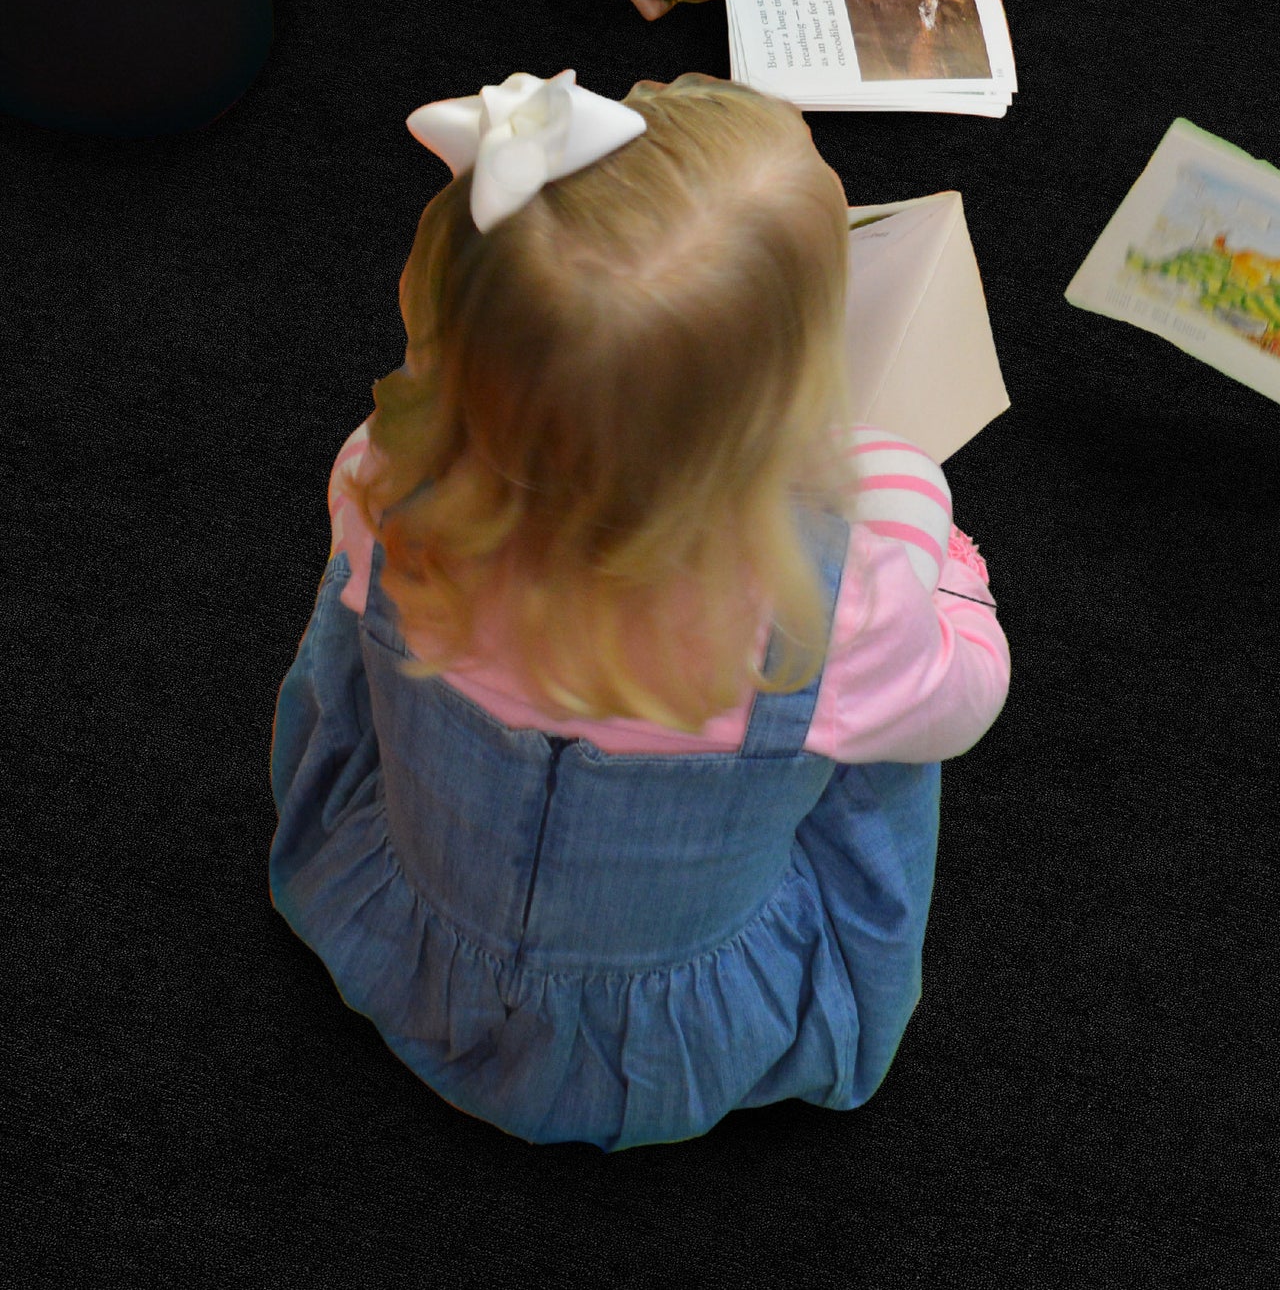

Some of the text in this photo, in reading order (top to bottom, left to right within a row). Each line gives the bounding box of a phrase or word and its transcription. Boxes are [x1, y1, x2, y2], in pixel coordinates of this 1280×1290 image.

[759, 9, 769, 25] can
[807, 0, 819, 16] for
[822, 0, 836, 16] and
[776, 9, 787, 30] long
[812, 17, 824, 40] hour
[763, 28, 774, 48] they
[796, 22, 812, 68] breathing
[828, 19, 846, 67] crocodiles
[767, 51, 778, 69] But
[783, 41, 794, 68] water
